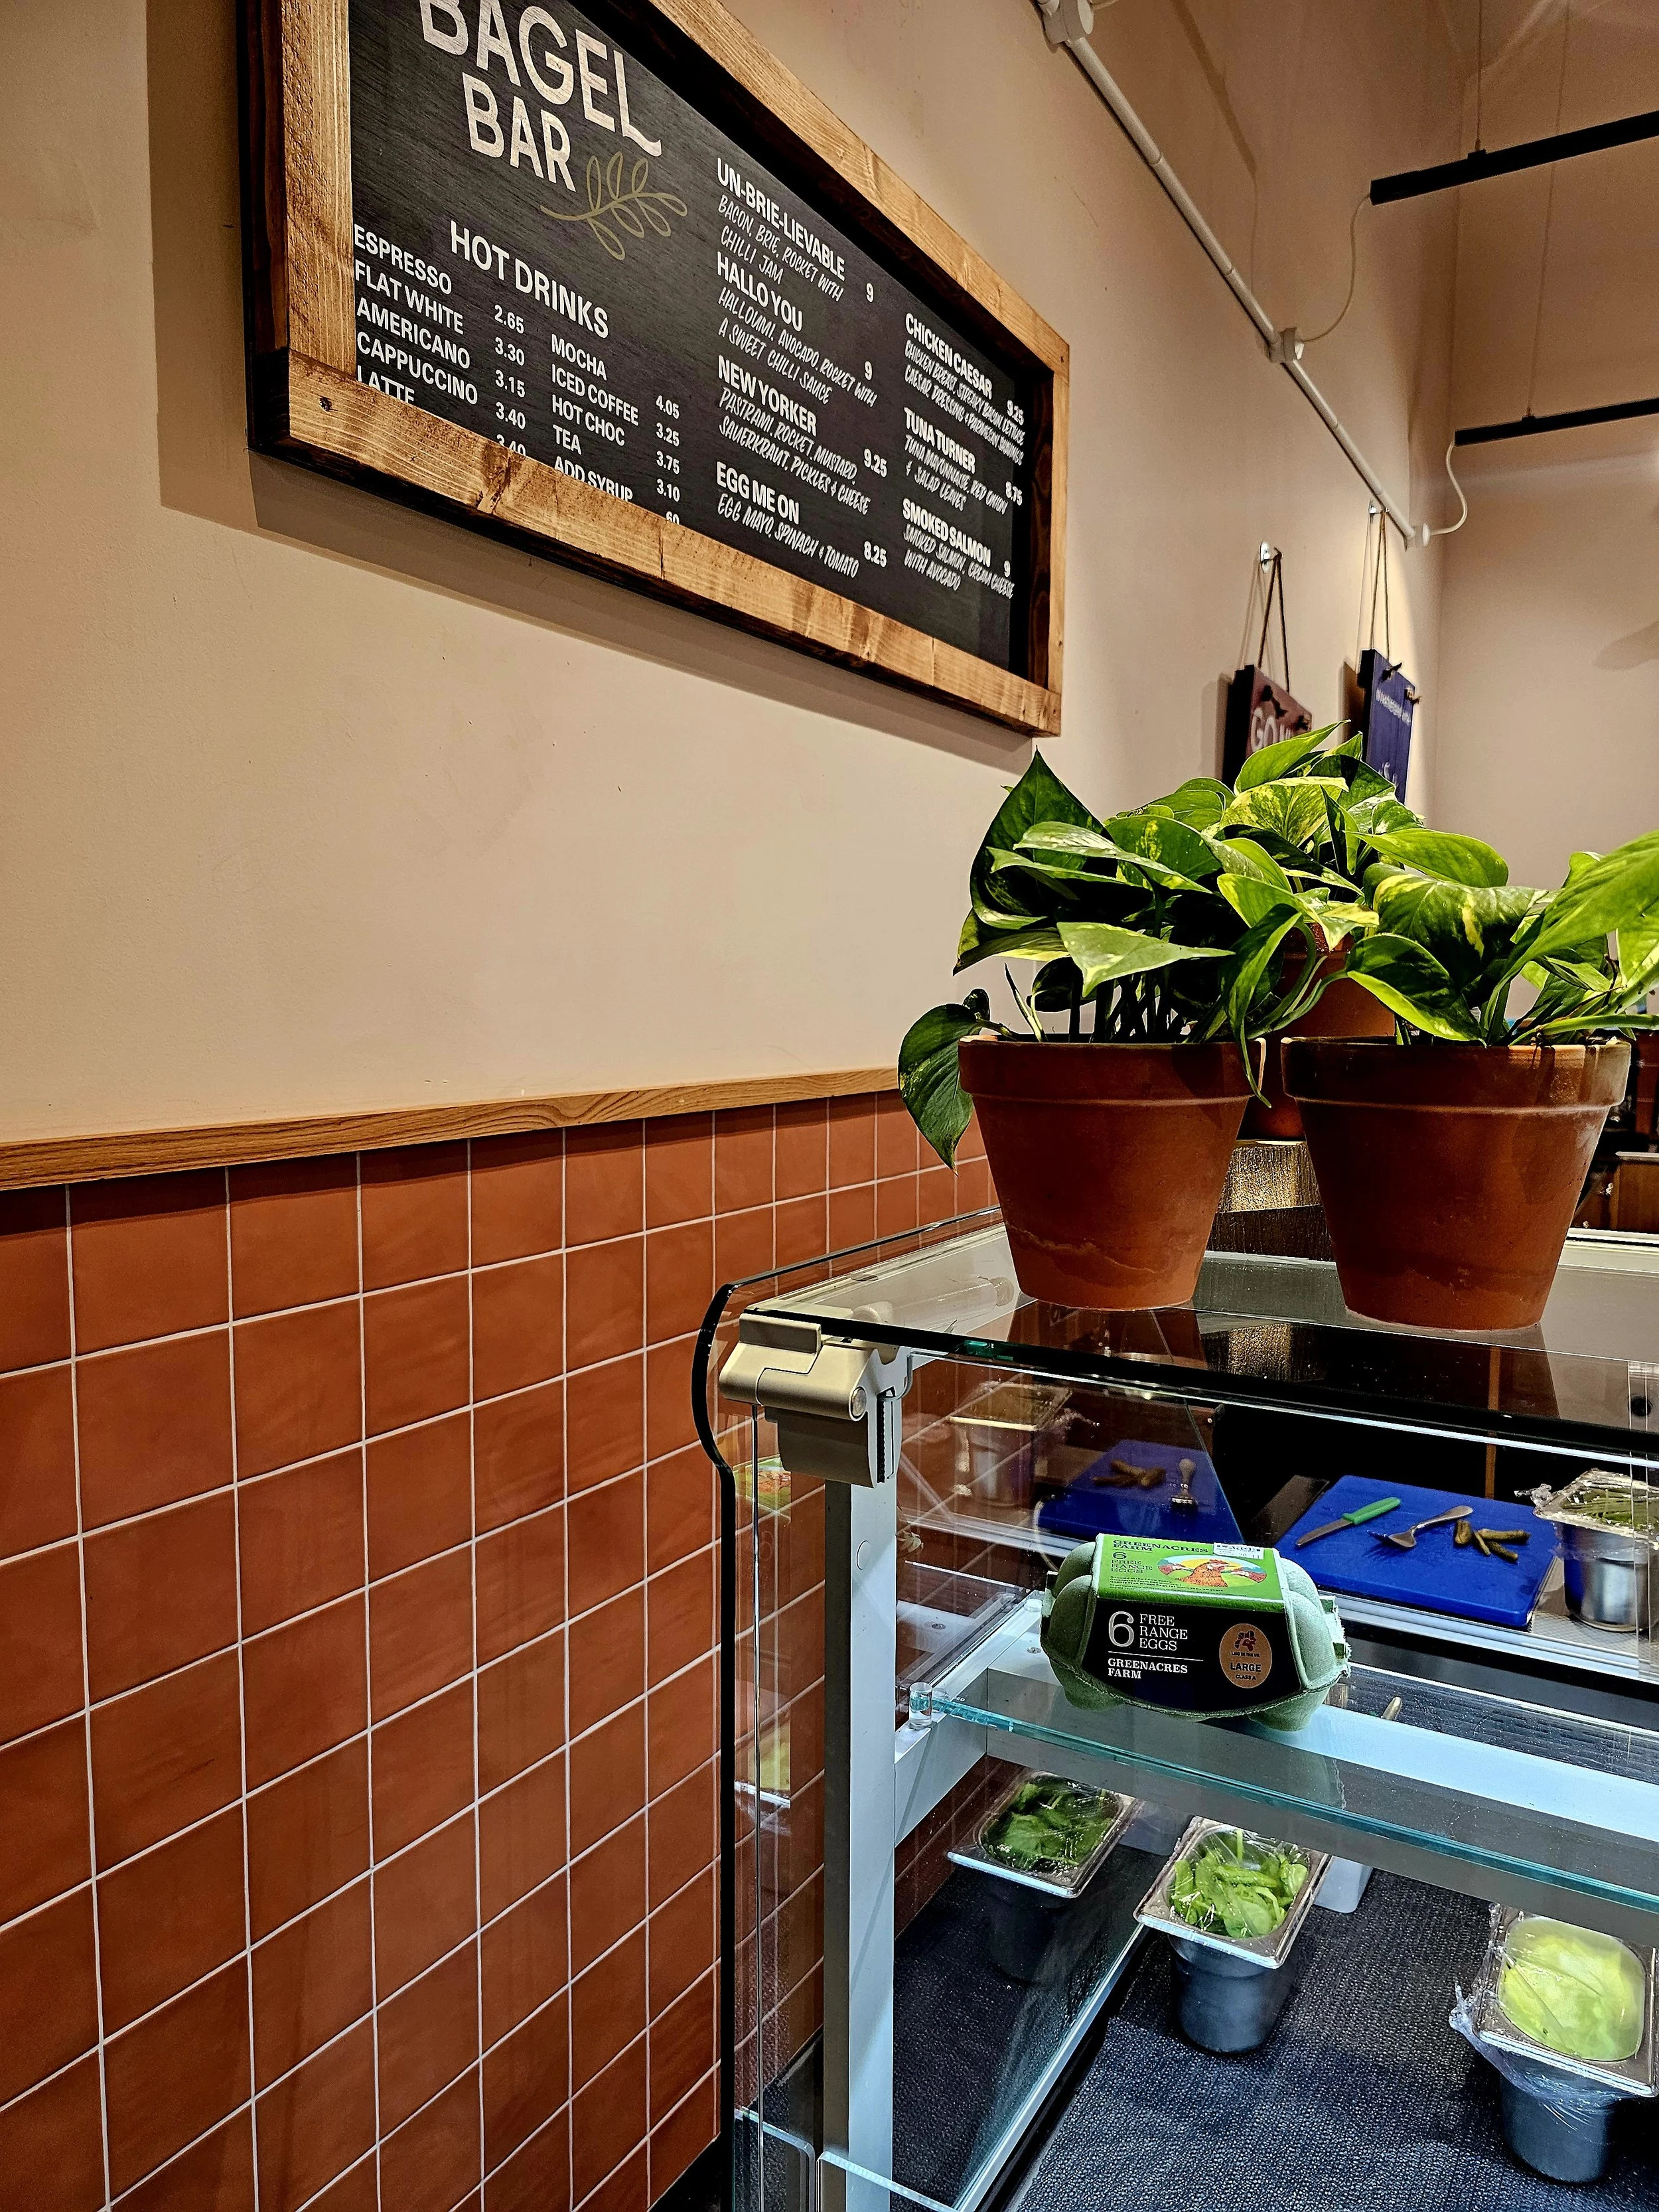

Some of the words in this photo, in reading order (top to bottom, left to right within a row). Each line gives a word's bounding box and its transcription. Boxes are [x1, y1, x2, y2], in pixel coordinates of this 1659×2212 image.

[420, 0, 662, 157] BAGEL
[463, 72, 576, 192] BAR
[717, 157, 845, 281] UN-BRIE-LIEVABLE
[866, 283, 874, 303] 9
[718, 194, 754, 237] BACON,
[755, 224, 781, 258] BRIE,
[782, 246, 819, 282] ROCKET
[818, 273, 845, 302] WITH
[721, 225, 757, 264] CHILLI
[758, 255, 784, 285] JAM
[354, 224, 452, 295] ESPRESSO
[494, 305, 524, 334] 2.65
[355, 259, 402, 301] FLAT
[404, 287, 464, 335] WHITE
[494, 337, 525, 366] 3.30
[451, 220, 510, 281] HOT
[516, 256, 609, 338] DRINKS
[717, 251, 768, 307] HALLO
[770, 290, 802, 332] YOU
[865, 360, 873, 380] 9
[357, 297, 470, 370] AMERICANO
[495, 370, 526, 398] 3.15
[357, 332, 478, 405] CAPPUCCINO
[496, 402, 526, 430] 3.40
[551, 333, 607, 382] MOCHA
[656, 395, 680, 419] 4.05
[718, 287, 776, 341] HALLOUMI,
[778, 329, 819, 371] AVOCADO,
[819, 358, 856, 392] ROCKET
[854, 382, 877, 407] WITH
[718, 317, 729, 337] A
[729, 324, 767, 360] SWEET
[767, 349, 800, 382] CHILLI
[799, 371, 833, 405] SAUCE
[904, 339, 935, 376] CHICKEN
[956, 382, 985, 414] STREAKY
[905, 313, 953, 367] CHICKEN
[953, 352, 993, 400] CAESAR
[552, 364, 585, 397] ICED
[587, 383, 639, 427] COFFEE
[656, 423, 680, 447] 3.25
[552, 394, 583, 421] HOT
[585, 411, 625, 447] CHOC
[656, 451, 680, 475] 3.75
[718, 354, 757, 399] NEW
[758, 379, 817, 437] YORKER
[863, 448, 888, 478] 9.25
[719, 387, 774, 437] PASTRAMI,
[774, 420, 814, 460] ROCKET,
[813, 445, 858, 486] MUSTARD,
[904, 364, 932, 398] CAESAR
[931, 384, 966, 423] DRESSING
[968, 413, 1001, 448] PARMESAN
[553, 424, 582, 455] TEA
[656, 479, 680, 502] 3.10
[555, 456, 585, 482] ADD
[587, 471, 633, 502] SYRUP
[719, 415, 791, 471] SAUERKRAUT,
[790, 455, 831, 493] PICKLES
[837, 484, 871, 516] CHEESE
[904, 407, 936, 447] TUNA
[934, 429, 975, 475] TURNER
[1005, 480, 1023, 506] 8.75
[904, 433, 926, 462] TUNA
[970, 479, 987, 501] RED
[985, 490, 1009, 515] ONION
[914, 466, 941, 493] SALAD
[939, 482, 968, 511] LEAVES
[717, 461, 750, 499] EGG
[752, 479, 776, 513] ME
[777, 494, 799, 525] ON
[863, 540, 887, 568] 8.25
[717, 493, 741, 522] EGG
[742, 506, 774, 538] MAYO,
[774, 522, 820, 558] SPINACH
[824, 545, 859, 579] TOMATO
[902, 498, 949, 542] SMOKED
[948, 526, 991, 567] SALMON
[1003, 560, 1011, 577] 9
[903, 523, 937, 553] SMOKED
[968, 561, 992, 587] CREAM
[904, 548, 929, 575] WITH
[926, 560, 962, 591] AVOCADO
[1113, 1540, 1208, 1553] GREENACRES
[1108, 1611, 1134, 1647] 6
[1139, 1613, 1175, 1626] FREE
[1139, 1625, 1188, 1640] RANGE
[1139, 1638, 1177, 1651] EGGS
[1108, 1658, 1188, 1674] GREENACRES
[1108, 1667, 1142, 1679] FARM
[1230, 1662, 1262, 1672] LARGE
